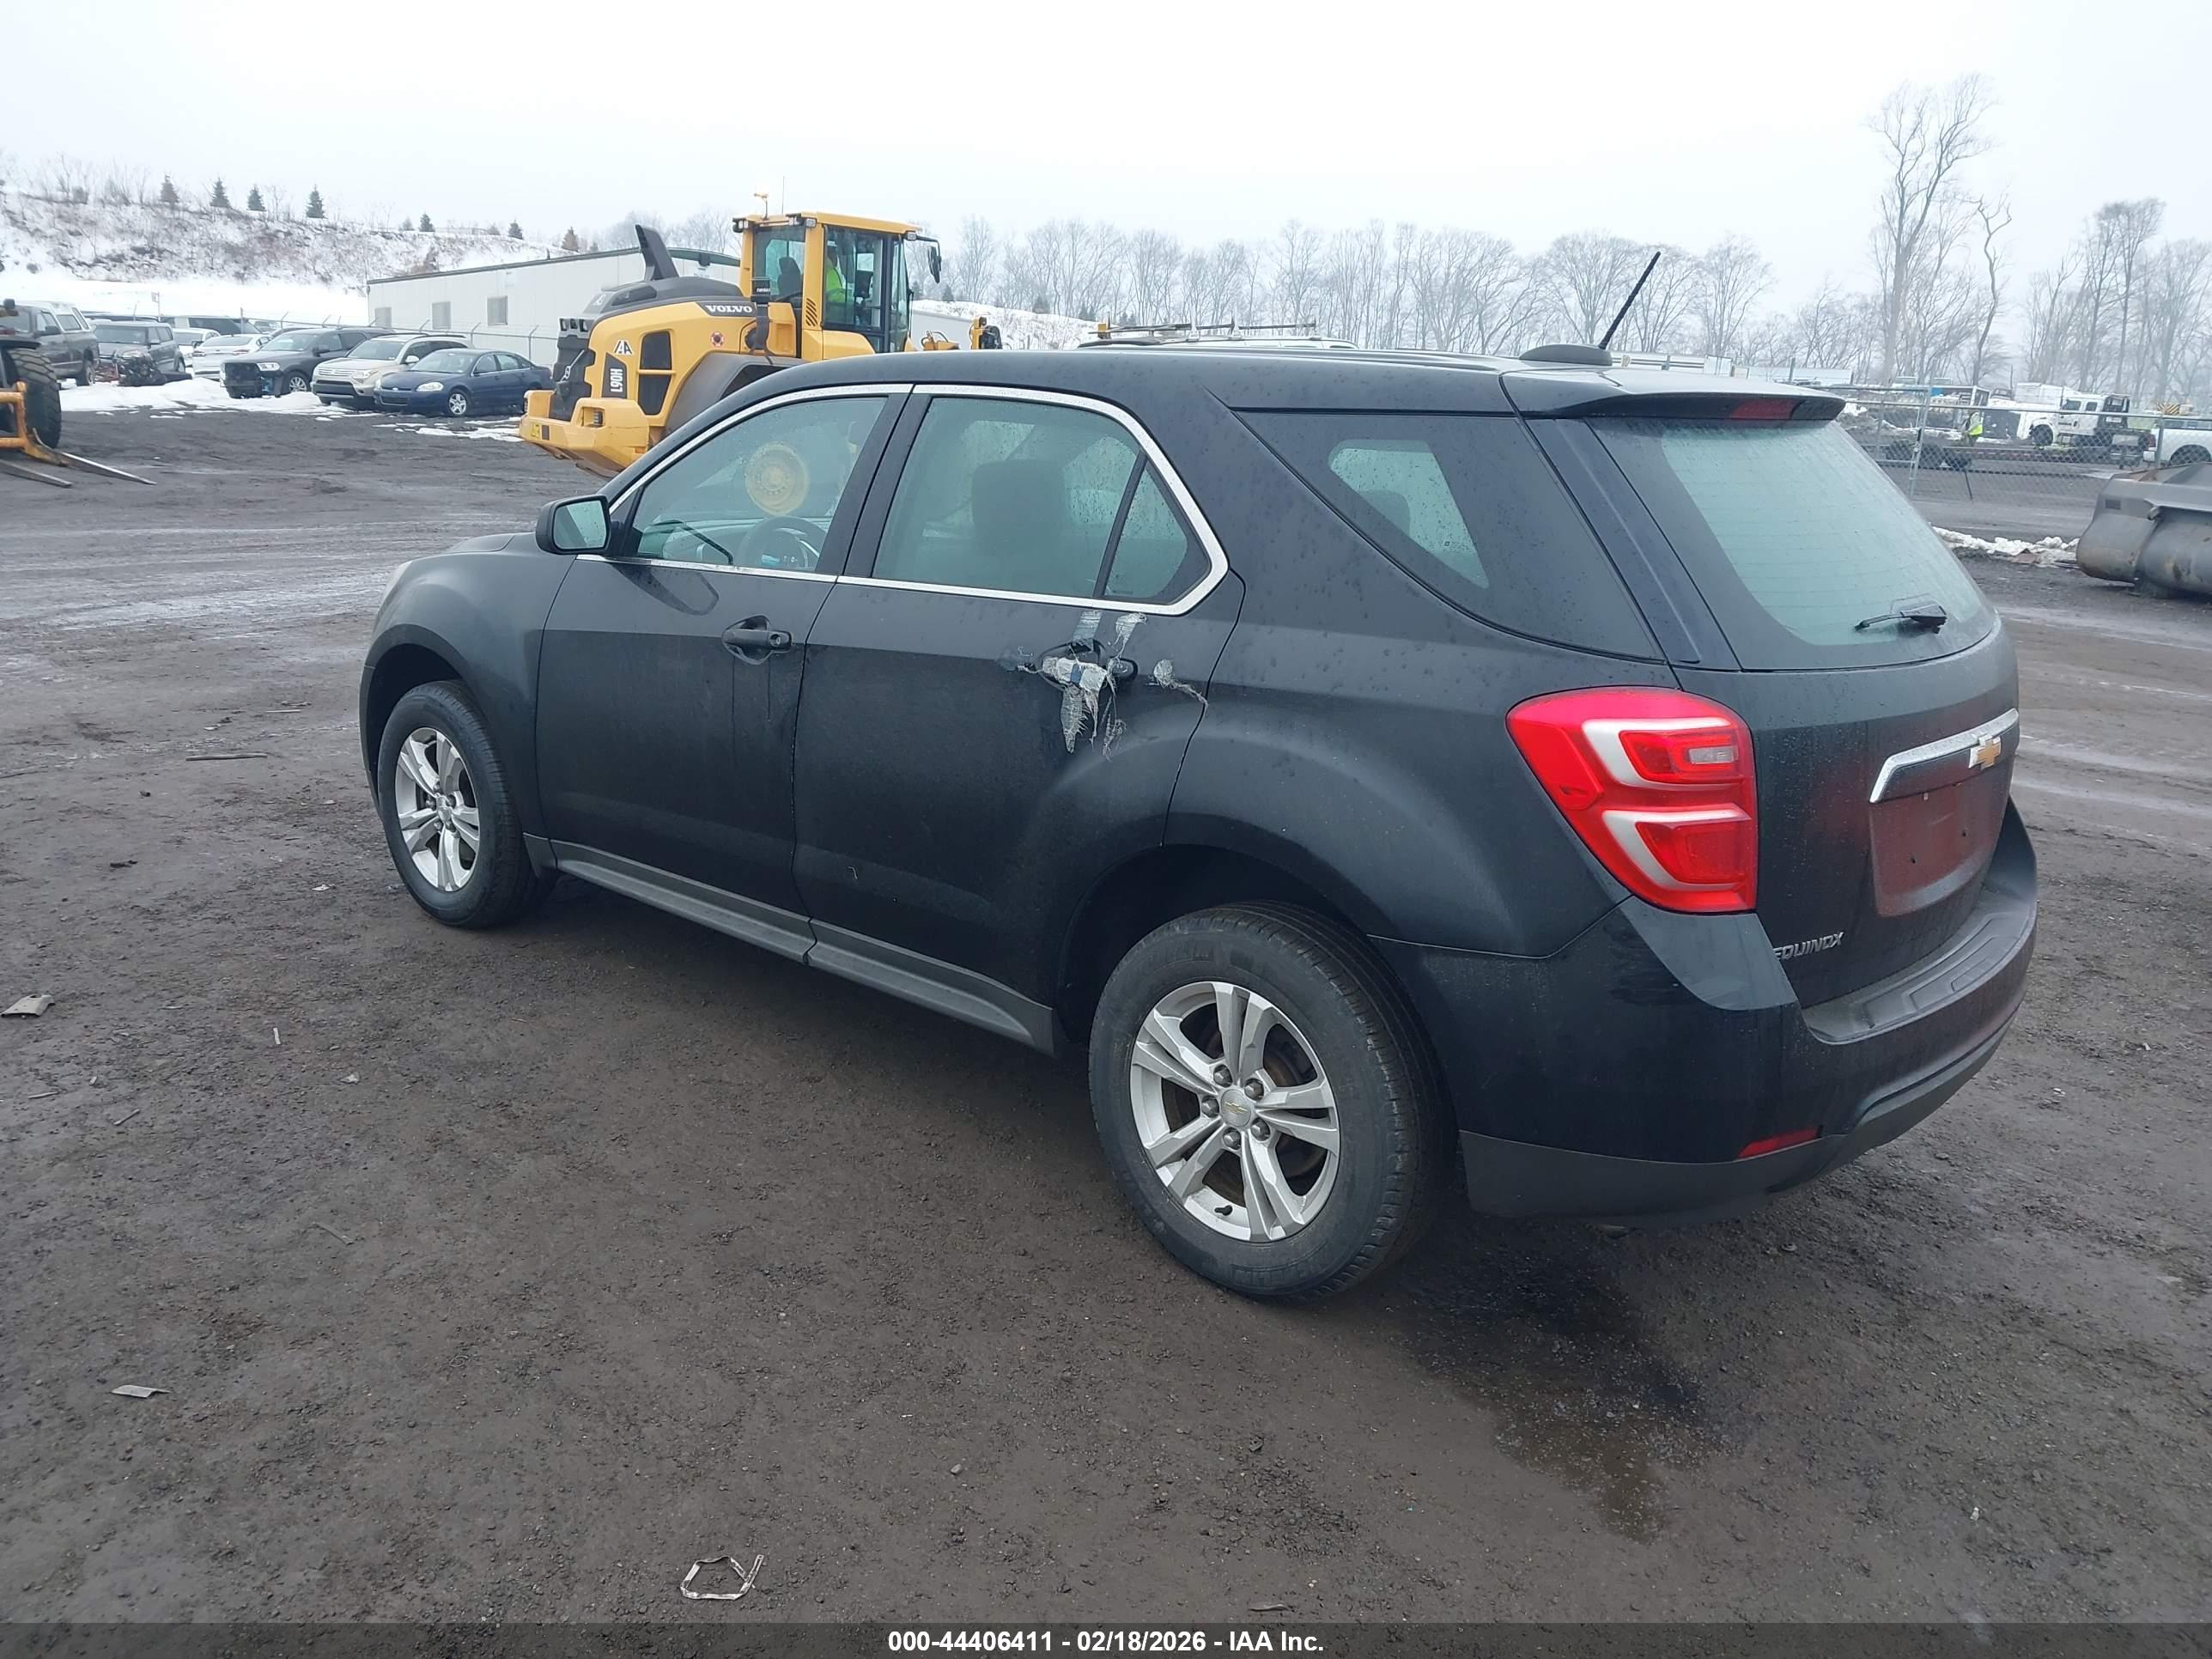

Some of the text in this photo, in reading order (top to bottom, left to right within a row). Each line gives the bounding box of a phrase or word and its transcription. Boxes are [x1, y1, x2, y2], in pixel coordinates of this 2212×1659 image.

[705, 304, 753, 313] VOLVO
[610, 368, 623, 392] L90H
[1772, 931, 1844, 961] EQUINOX
